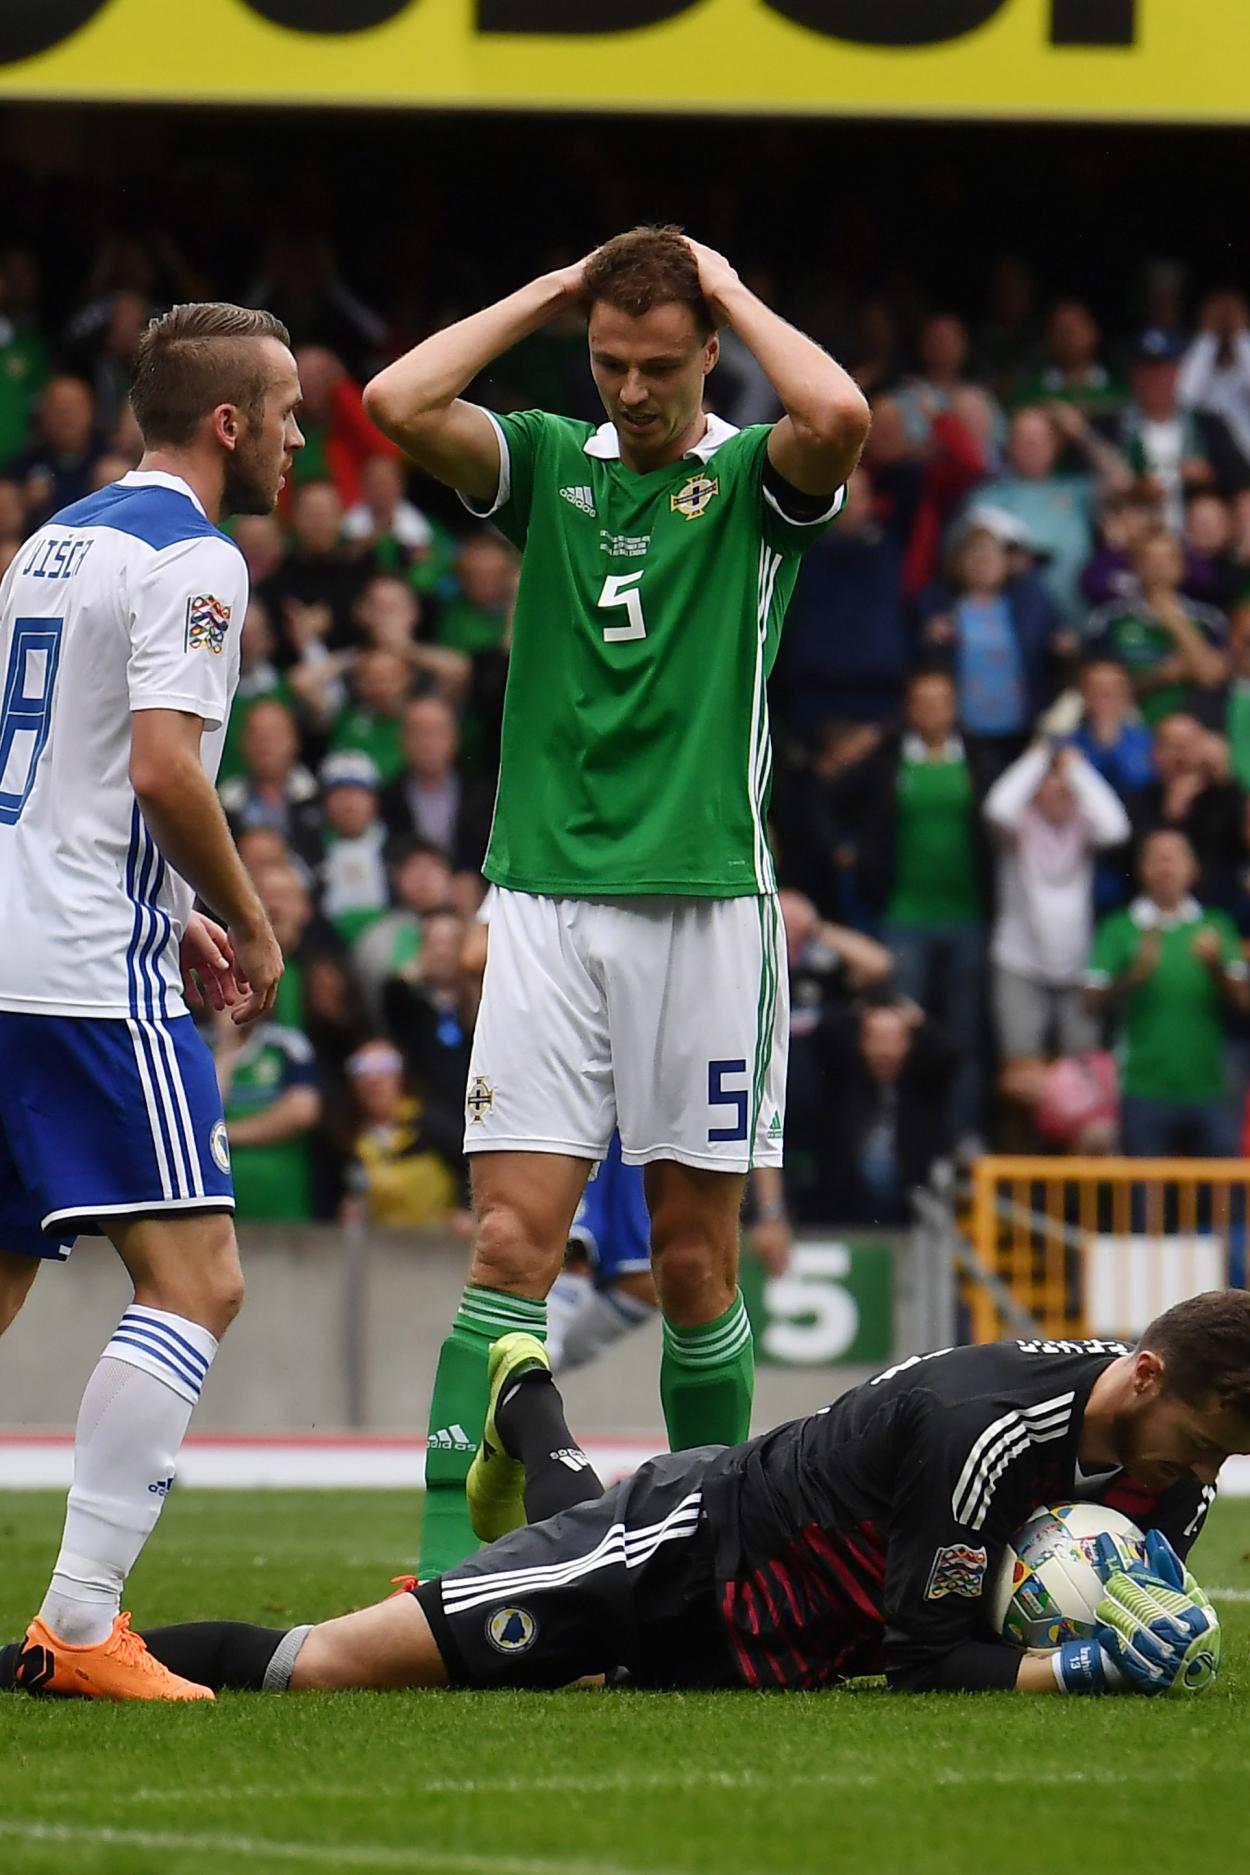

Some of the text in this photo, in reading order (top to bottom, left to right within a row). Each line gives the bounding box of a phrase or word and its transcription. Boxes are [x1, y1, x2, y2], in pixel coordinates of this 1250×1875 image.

[559, 488, 596, 518] adidas
[598, 570, 646, 642] 5
[0, 617, 64, 825] 8
[708, 1059, 748, 1142] 5
[764, 1243, 858, 1363] 5
